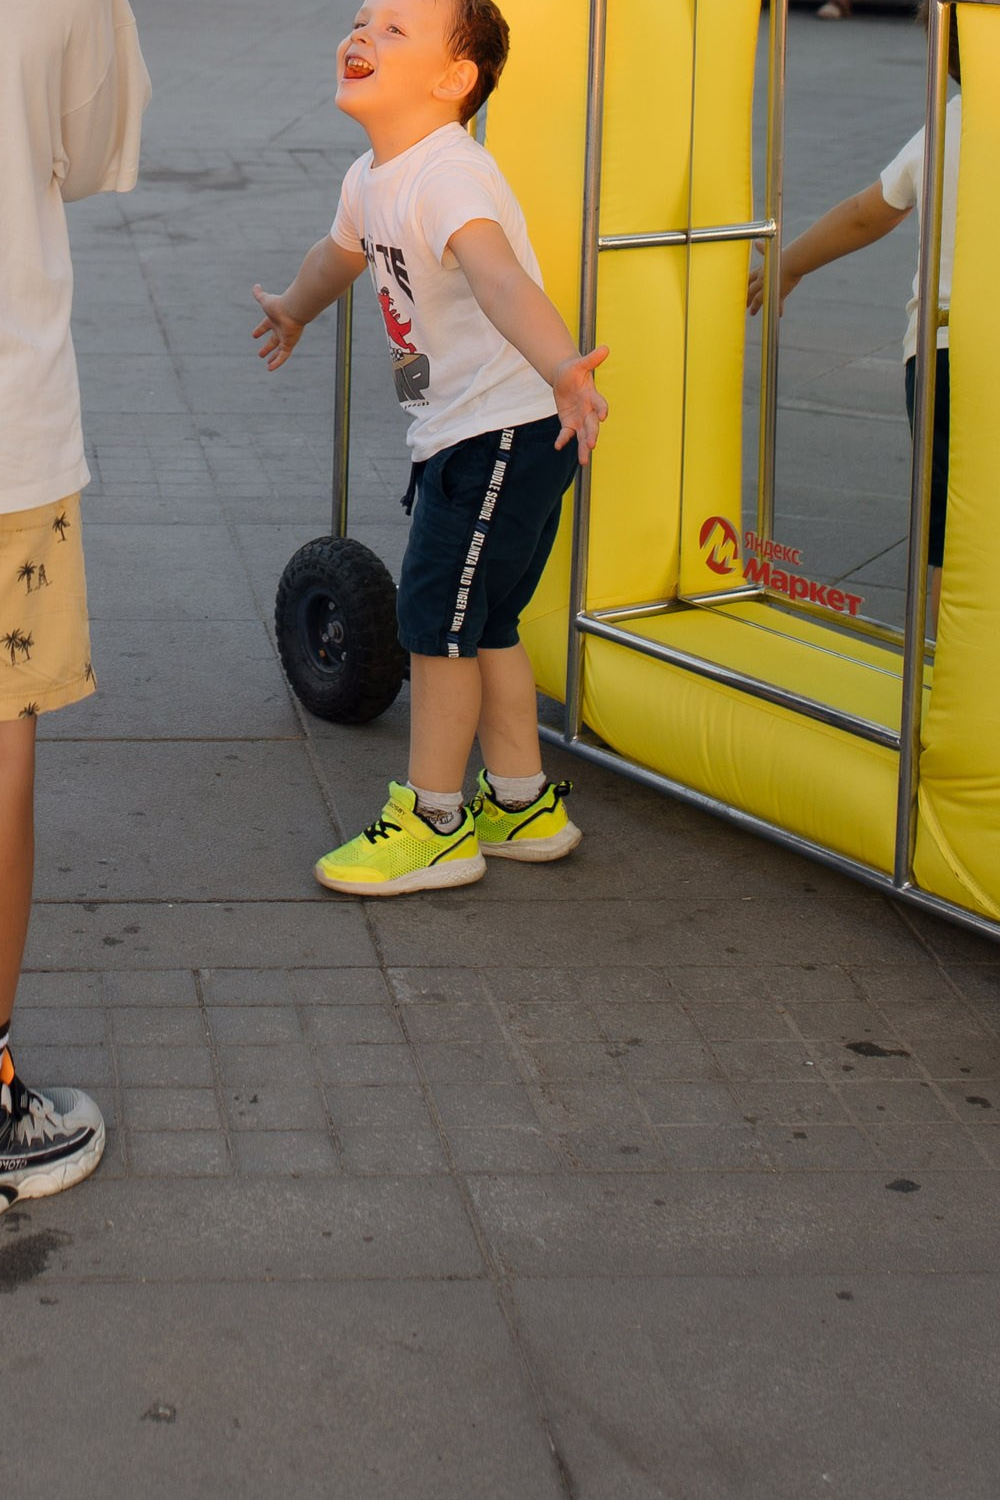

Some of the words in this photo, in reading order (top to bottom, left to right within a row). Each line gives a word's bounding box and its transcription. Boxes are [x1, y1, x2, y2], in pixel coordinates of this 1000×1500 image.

[499, 429, 515, 450] TEAM
[489, 460, 507, 491] MIDDLE
[479, 491, 498, 521] SCHOOL
[465, 530, 486, 566] ATLANTA
[744, 531, 802, 566] Яндекс
[460, 566, 476, 586] WILD
[743, 557, 864, 616] Маркет
[455, 587, 470, 610] TIGER
[449, 612, 465, 632] TEAM
